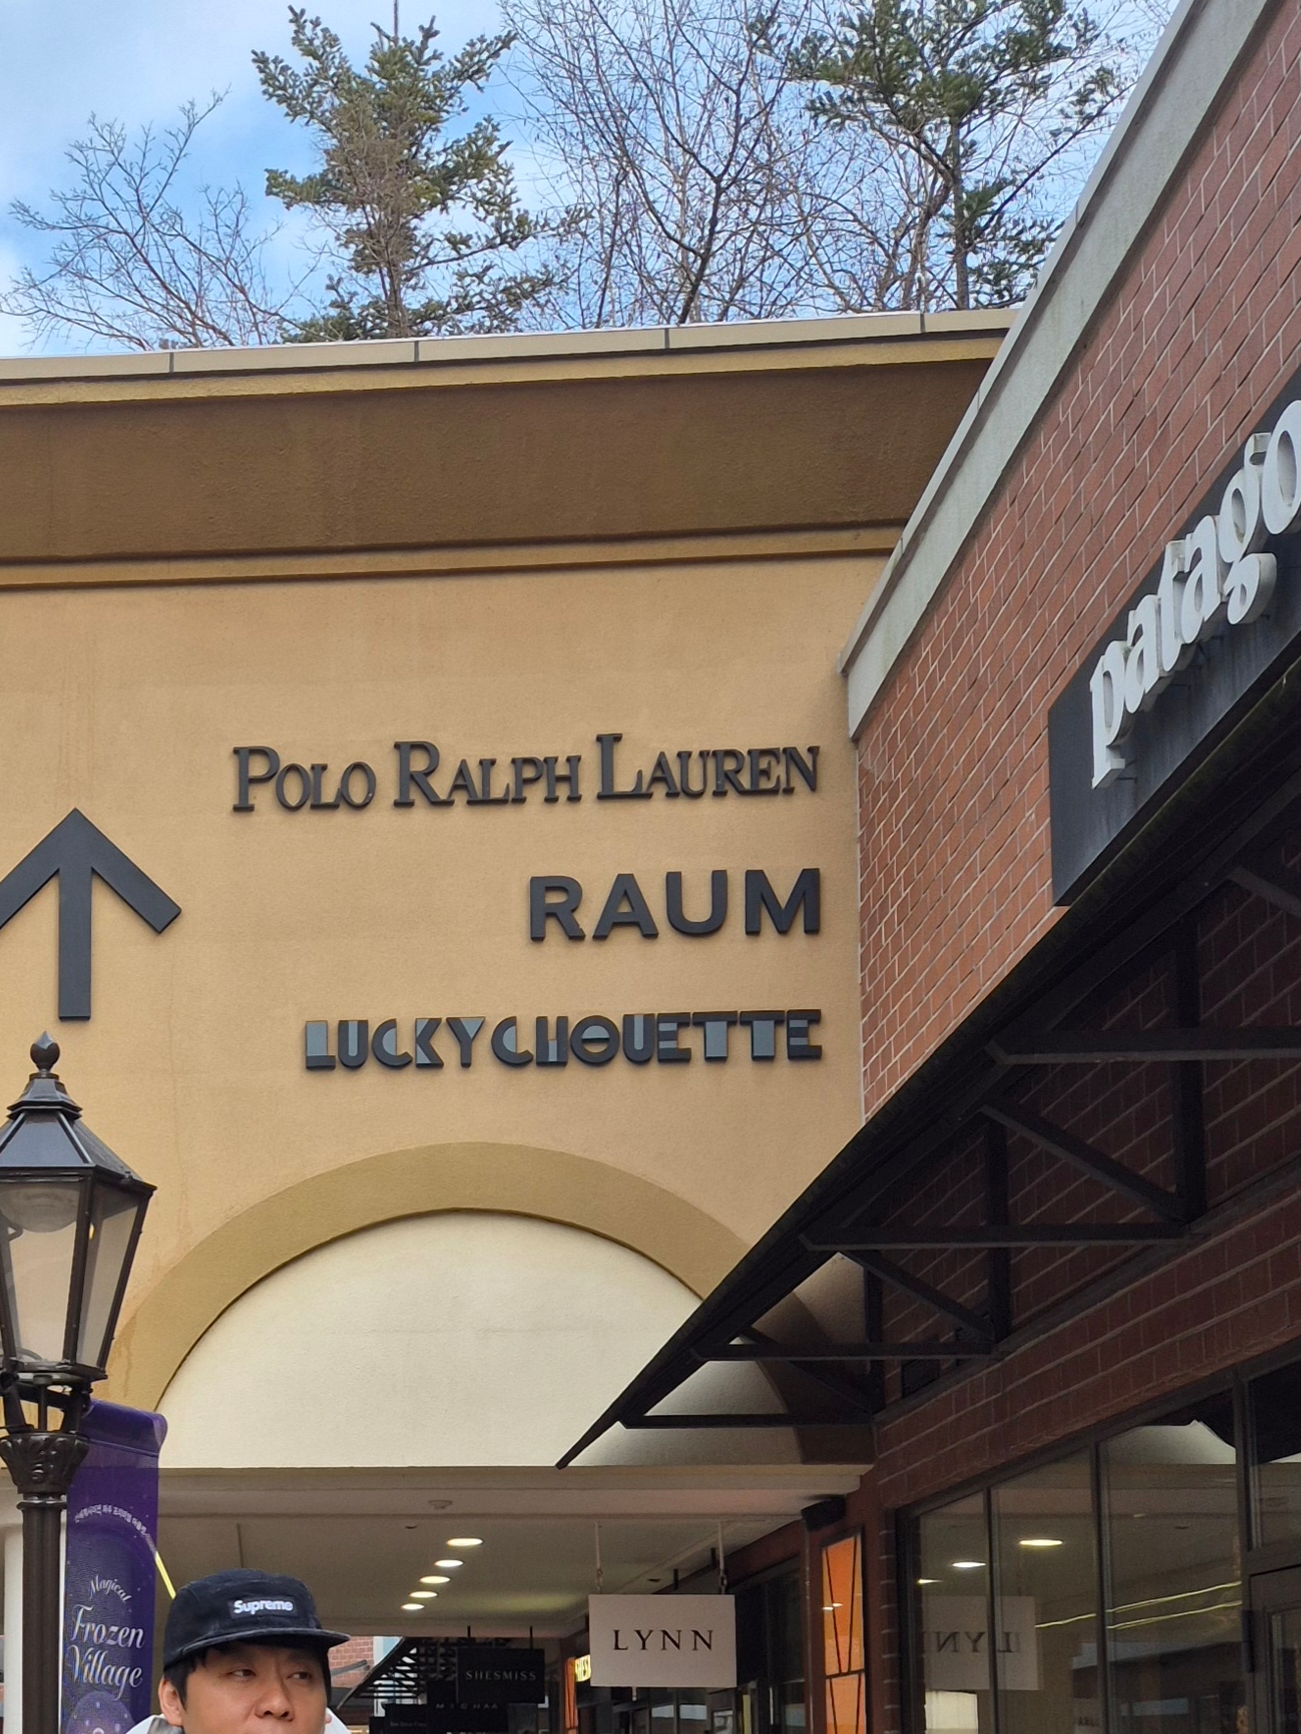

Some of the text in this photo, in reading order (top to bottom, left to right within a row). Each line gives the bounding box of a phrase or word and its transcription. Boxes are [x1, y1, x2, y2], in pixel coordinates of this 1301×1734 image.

[232, 733, 820, 813] POLO RALPH LAUREN
[529, 868, 820, 941] RAUM
[89, 1574, 132, 1603] Magical
[233, 1599, 293, 1615] Supreme
[71, 1603, 145, 1649] Frozen
[613, 1629, 713, 1650] LYNN
[67, 1644, 143, 1701] Village
[465, 1670, 537, 1681] SHESMISS
